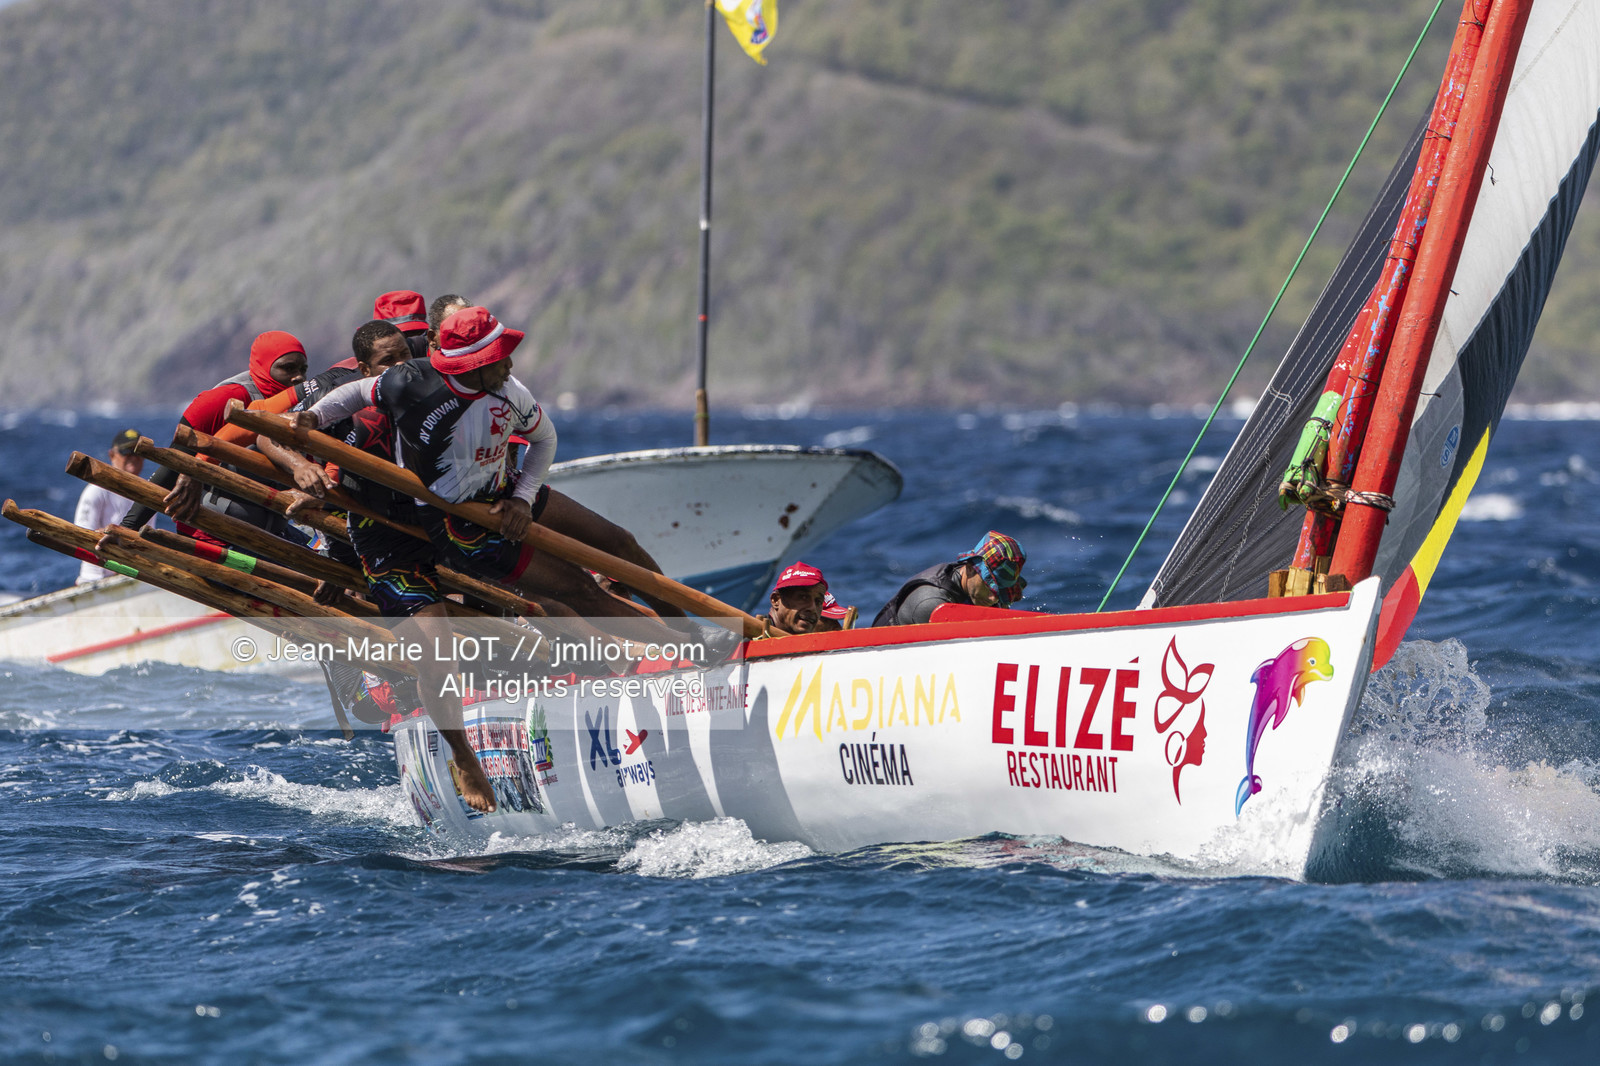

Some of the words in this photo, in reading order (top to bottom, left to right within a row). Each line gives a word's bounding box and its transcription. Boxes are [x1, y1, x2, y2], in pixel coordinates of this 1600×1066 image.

[422, 397, 460, 431] DOUVAN
[419, 428, 431, 445] AY
[697, 683, 749, 712] SAINTE-ANNE
[775, 660, 962, 744] MADIANA
[992, 655, 1141, 752] ELIZÉ
[585, 705, 622, 771] XL
[839, 731, 914, 786] CINÉMA
[616, 760, 656, 788] airways
[1007, 750, 1119, 793] RESTAURANT
